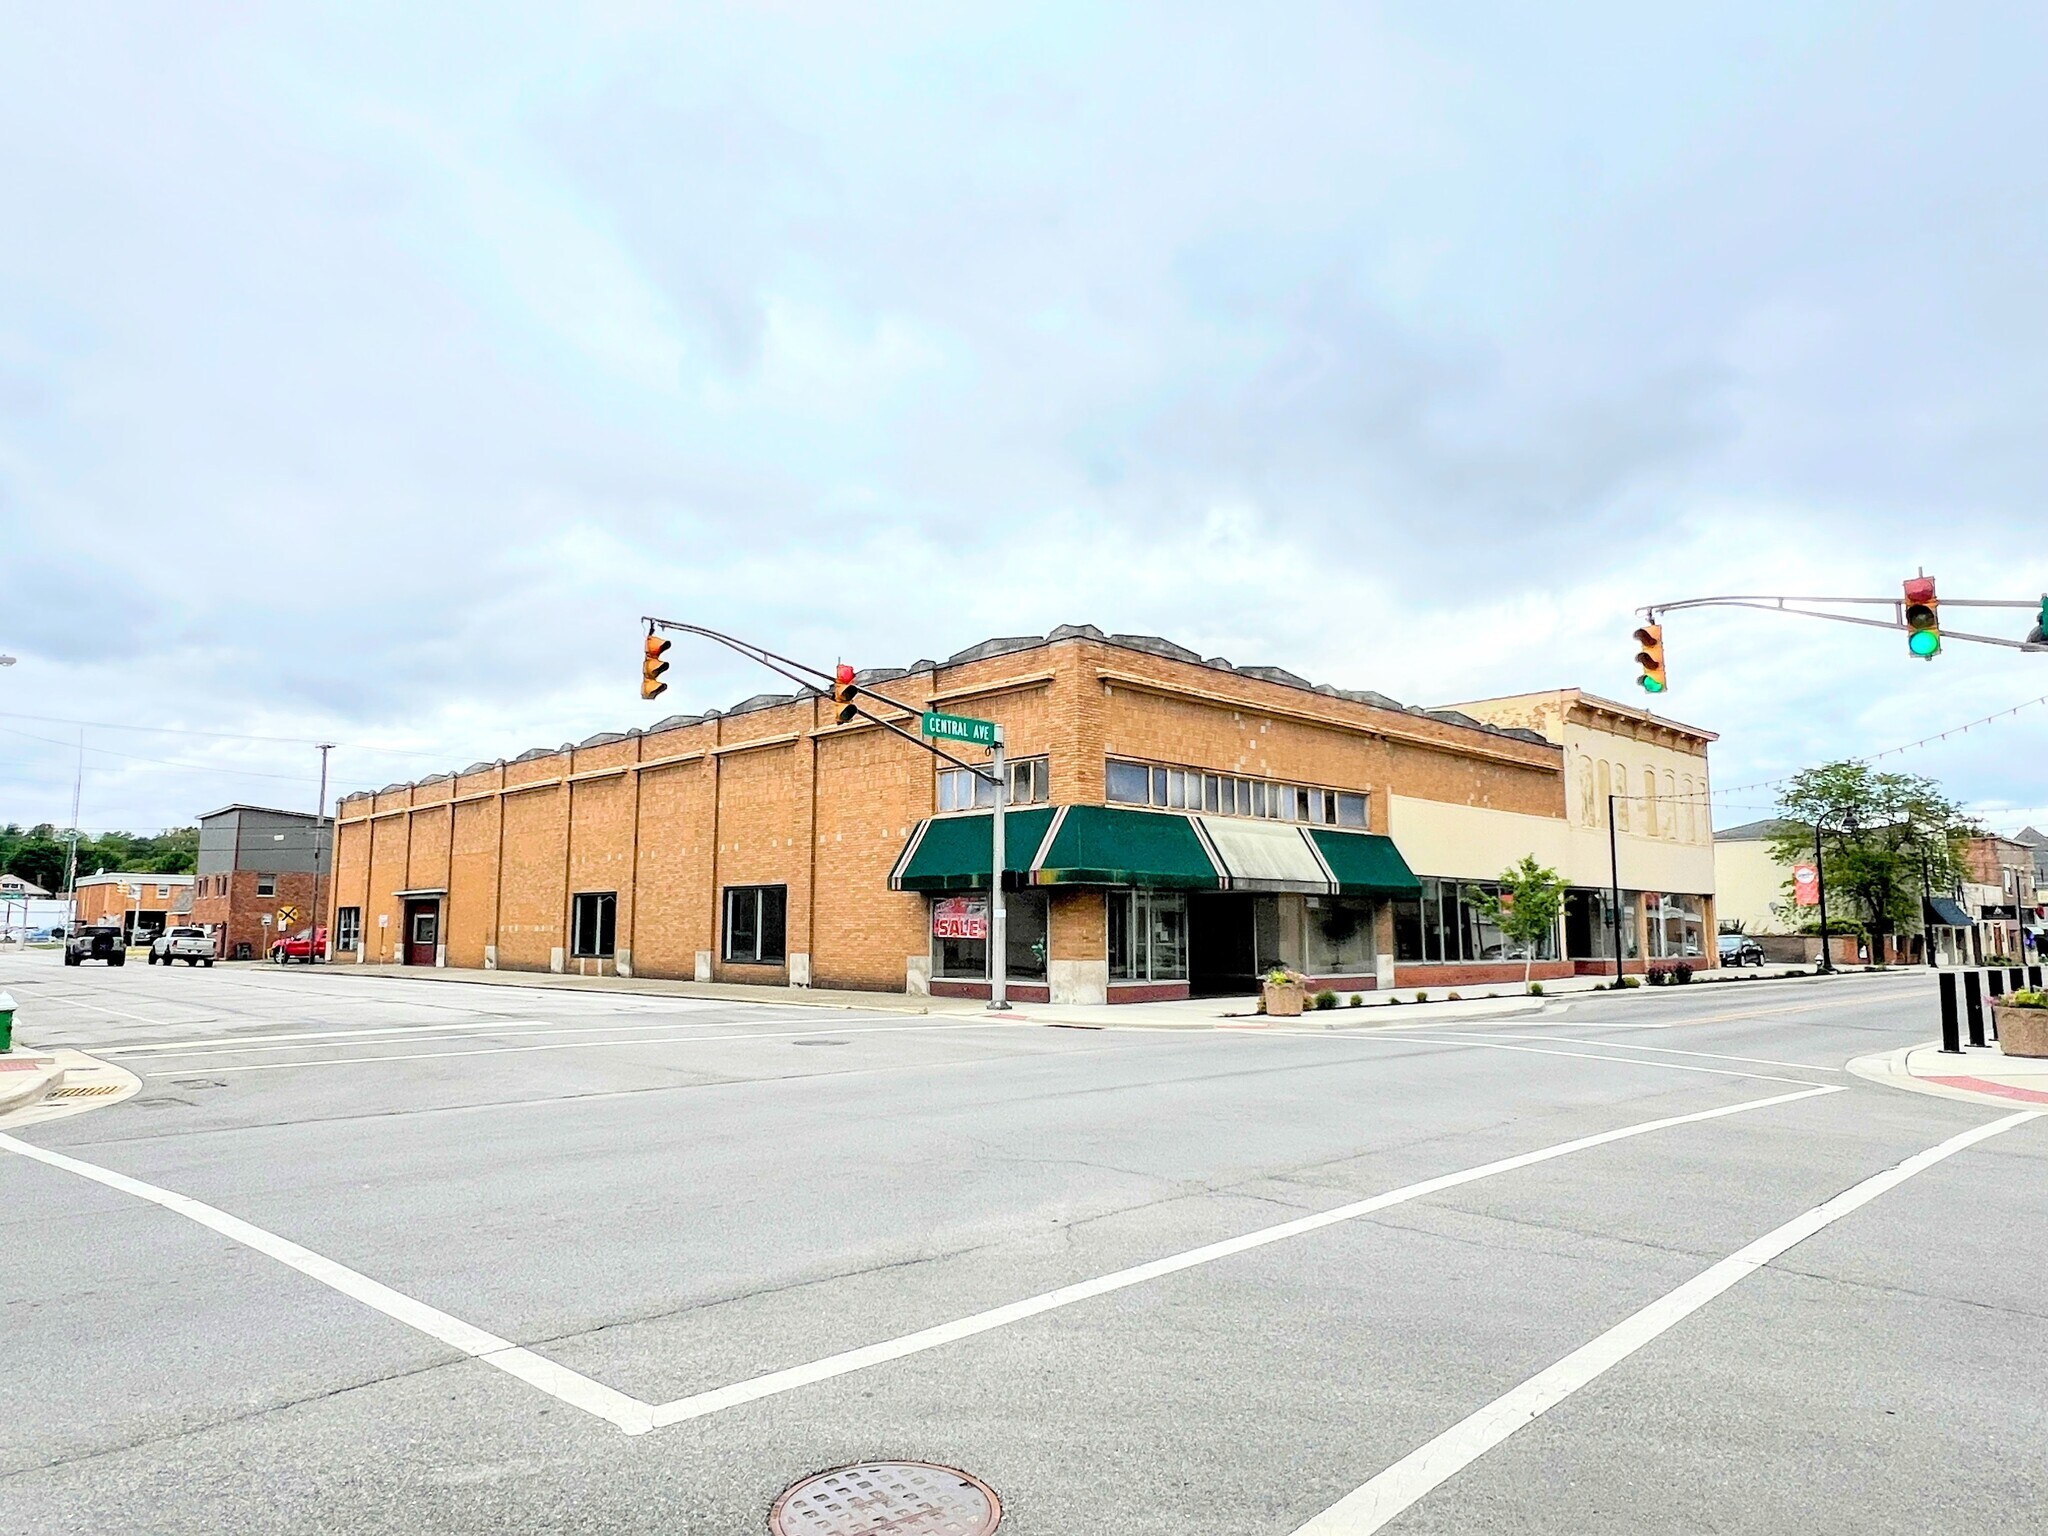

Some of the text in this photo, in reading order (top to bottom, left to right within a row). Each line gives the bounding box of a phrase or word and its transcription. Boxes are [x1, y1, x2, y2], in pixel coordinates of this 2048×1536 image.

[929, 717, 989, 740] CENTRAL AVE
[939, 919, 978, 937] SALE
